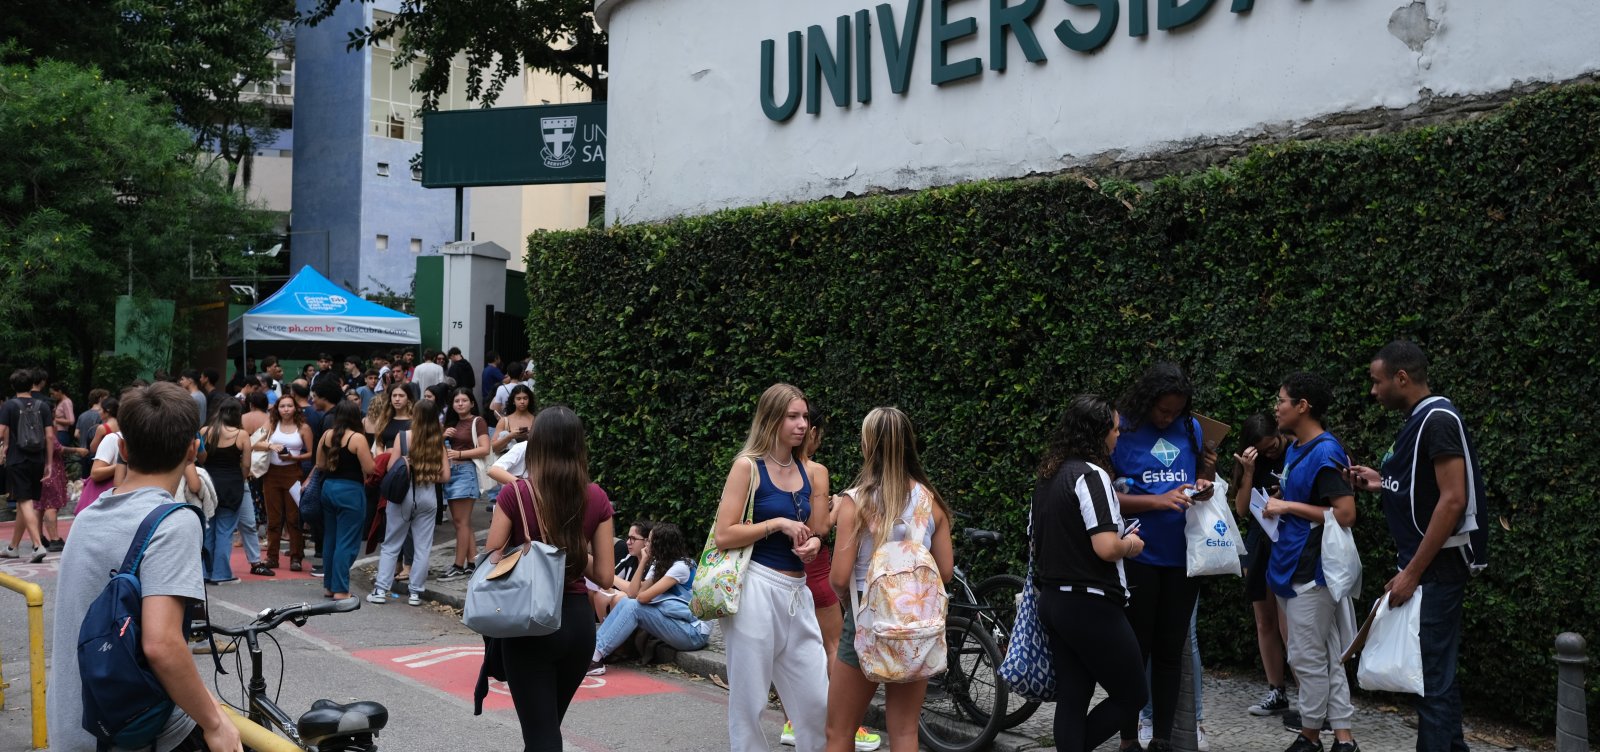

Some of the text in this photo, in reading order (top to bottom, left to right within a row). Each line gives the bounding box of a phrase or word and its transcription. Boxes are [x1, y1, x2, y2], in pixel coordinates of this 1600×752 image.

[759, 0, 1312, 122] UNIVERS
[256, 323, 287, 332] Acesse
[288, 324, 335, 333] ph.com.br
[344, 325, 383, 334] descubra
[452, 321, 463, 329] 75
[1206, 538, 1234, 548] Estáci
